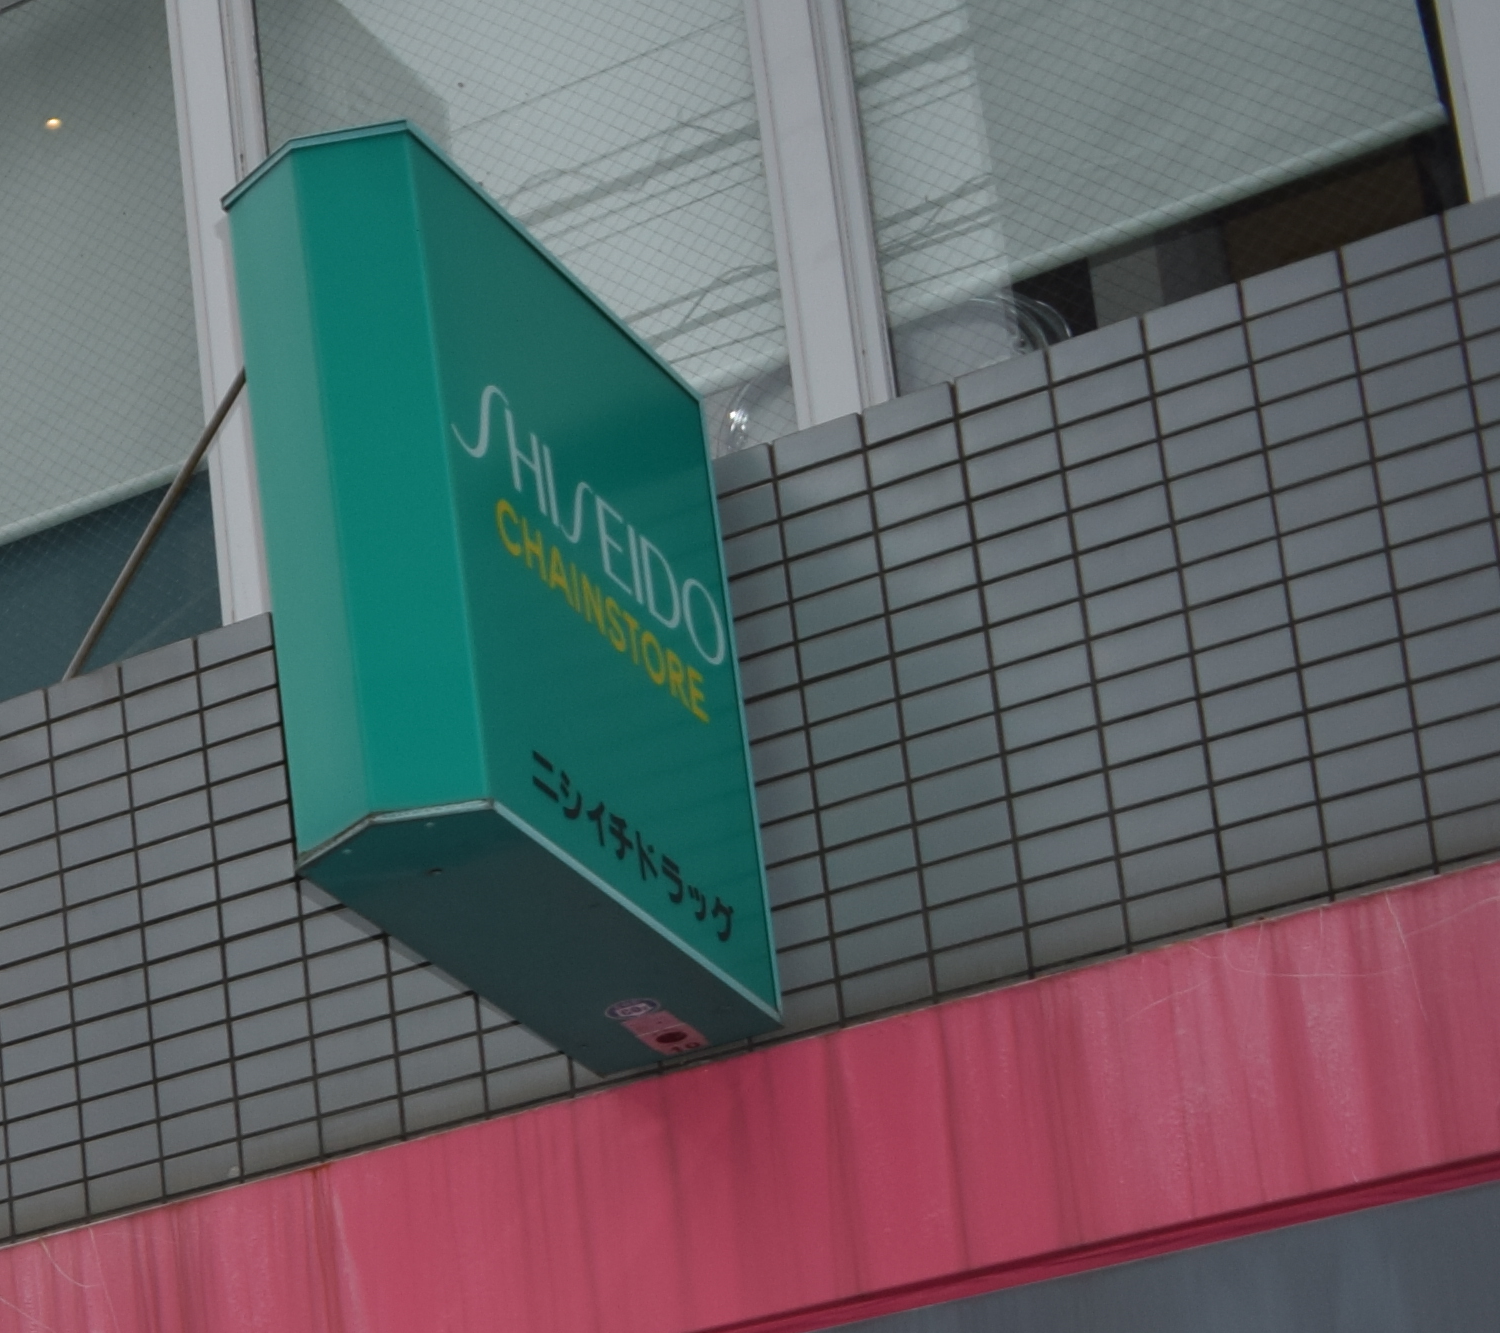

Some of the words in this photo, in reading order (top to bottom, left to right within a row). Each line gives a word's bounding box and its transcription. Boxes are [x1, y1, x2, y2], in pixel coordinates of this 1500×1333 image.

[451, 383, 727, 664] SHISEIDO
[495, 498, 710, 723] CHAINSTORE
[531, 748, 735, 942] ニシイチドラッグ
